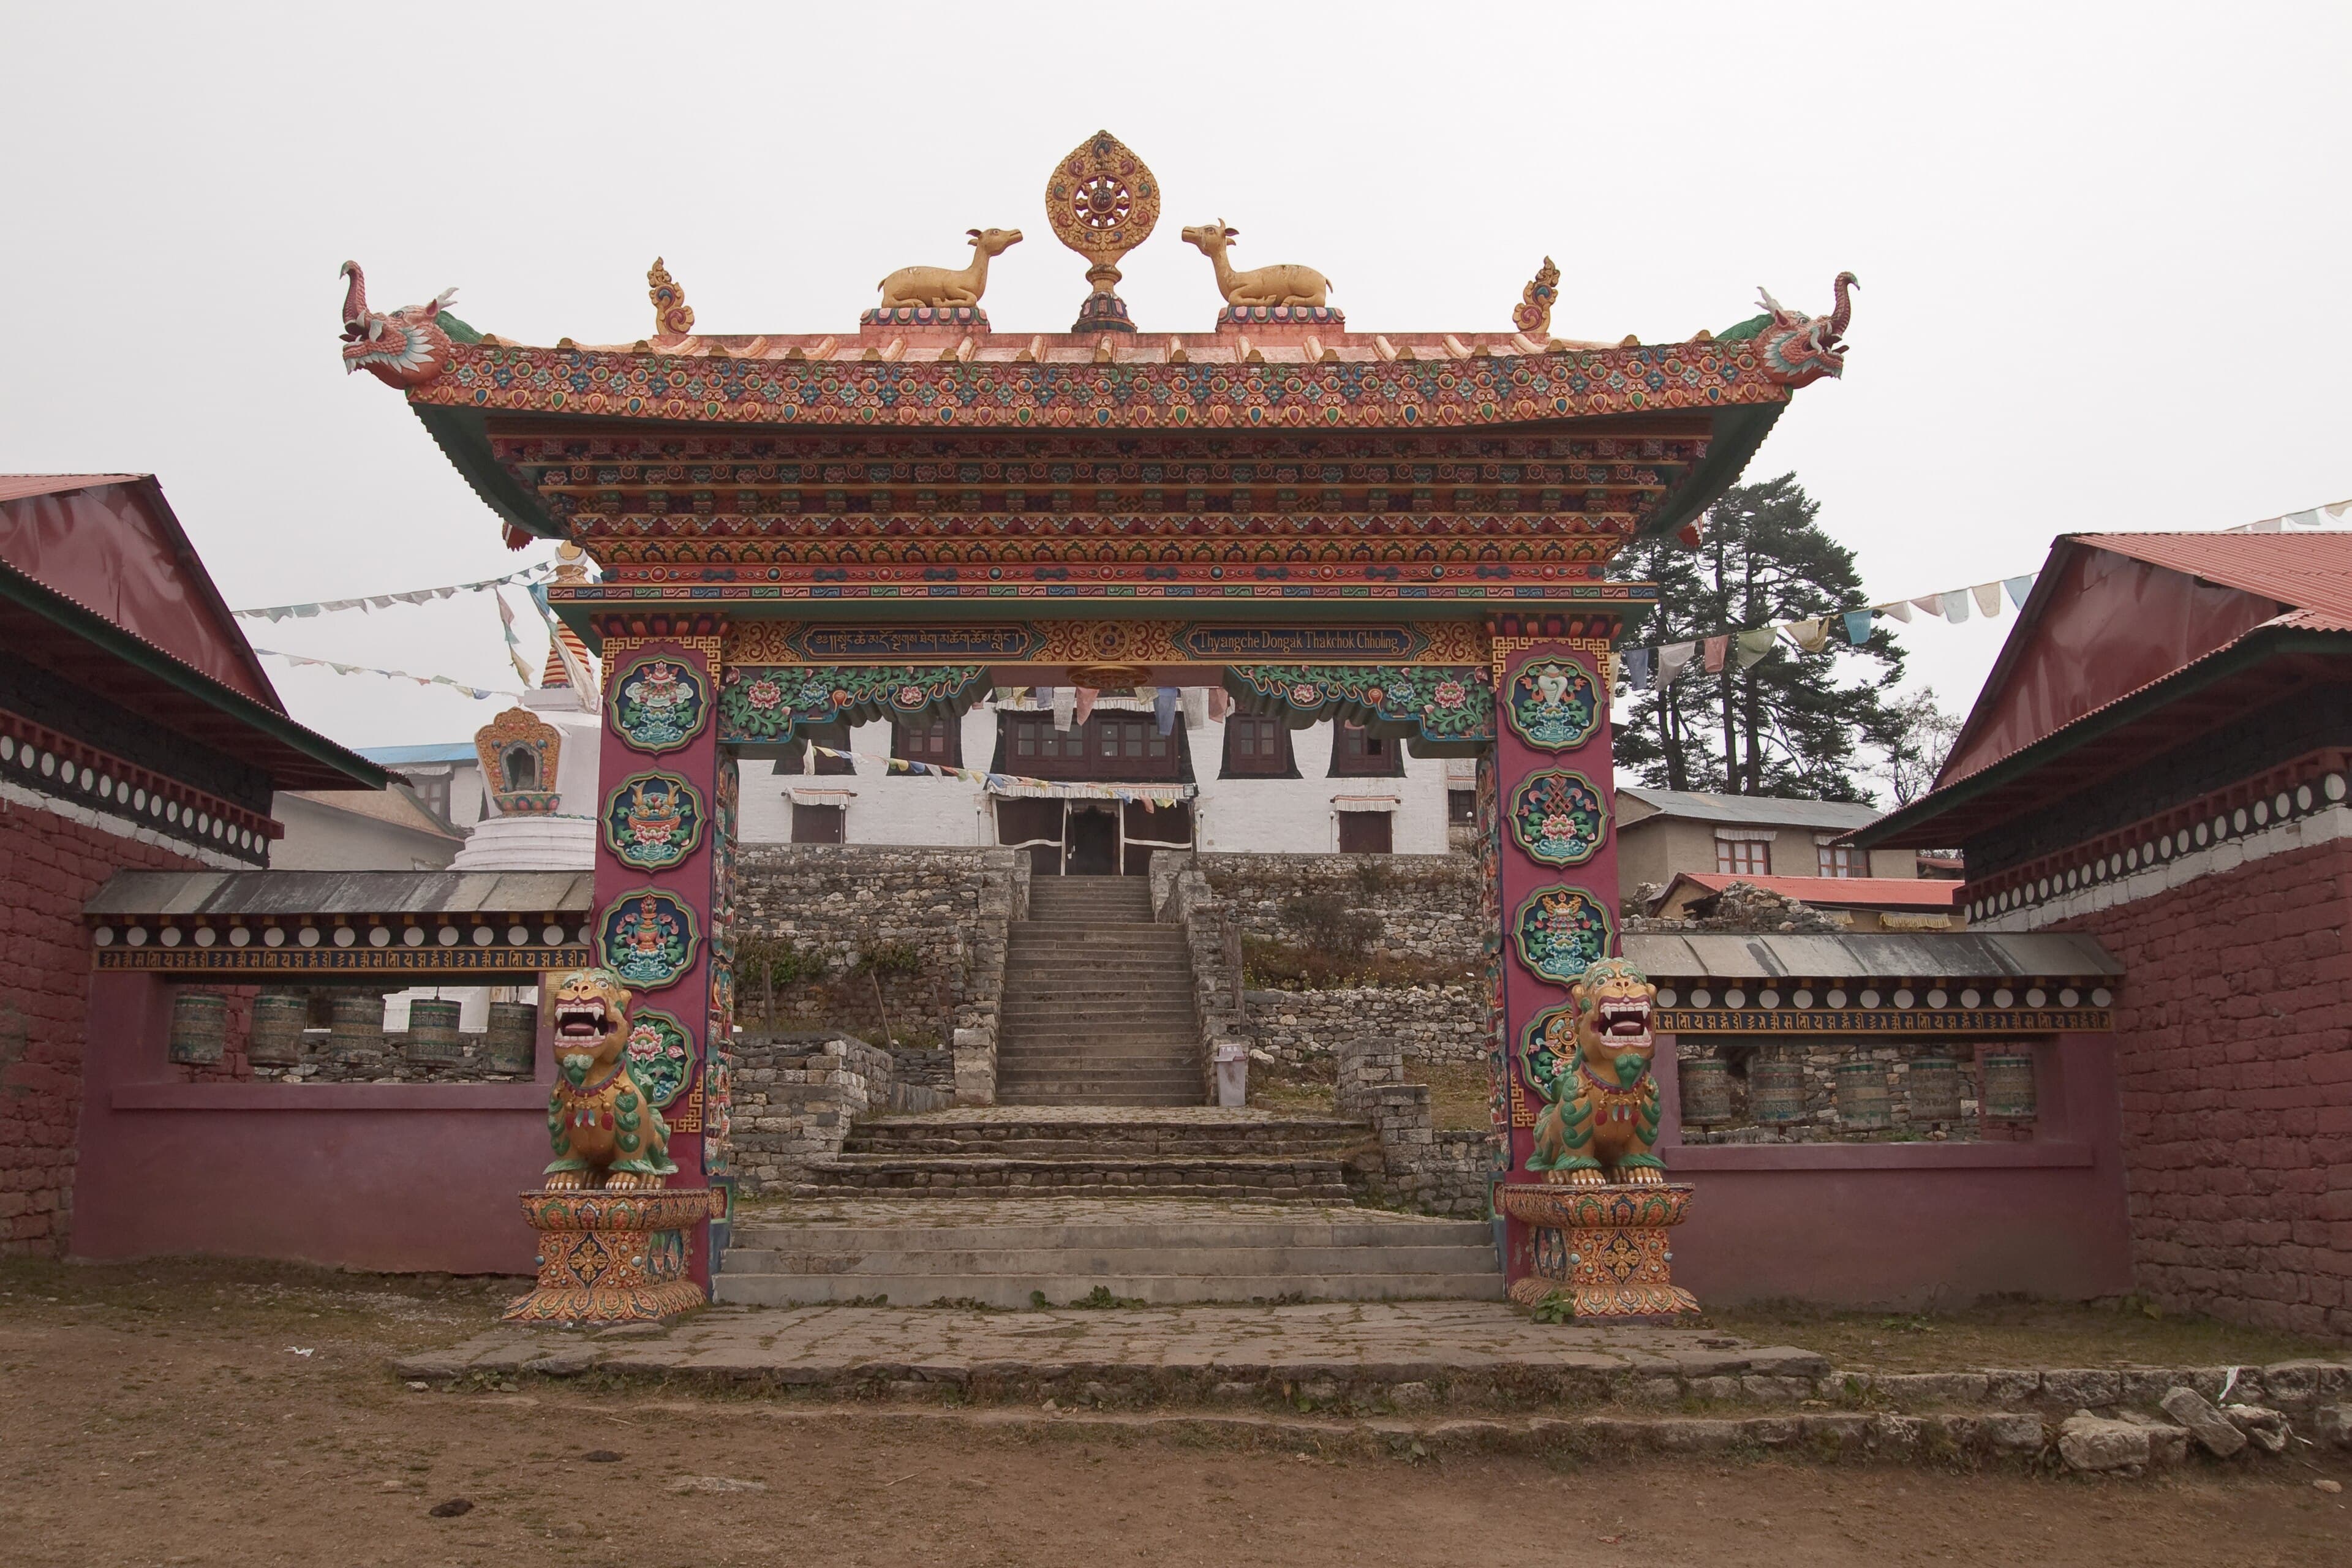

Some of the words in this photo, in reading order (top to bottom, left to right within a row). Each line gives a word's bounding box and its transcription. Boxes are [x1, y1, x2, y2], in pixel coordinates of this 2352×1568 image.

[1199, 631, 1259, 652] Thyangche
[1262, 631, 1303, 652] Dongak
[1305, 631, 1355, 648] Thakchok
[1357, 631, 1399, 653] Chholing
